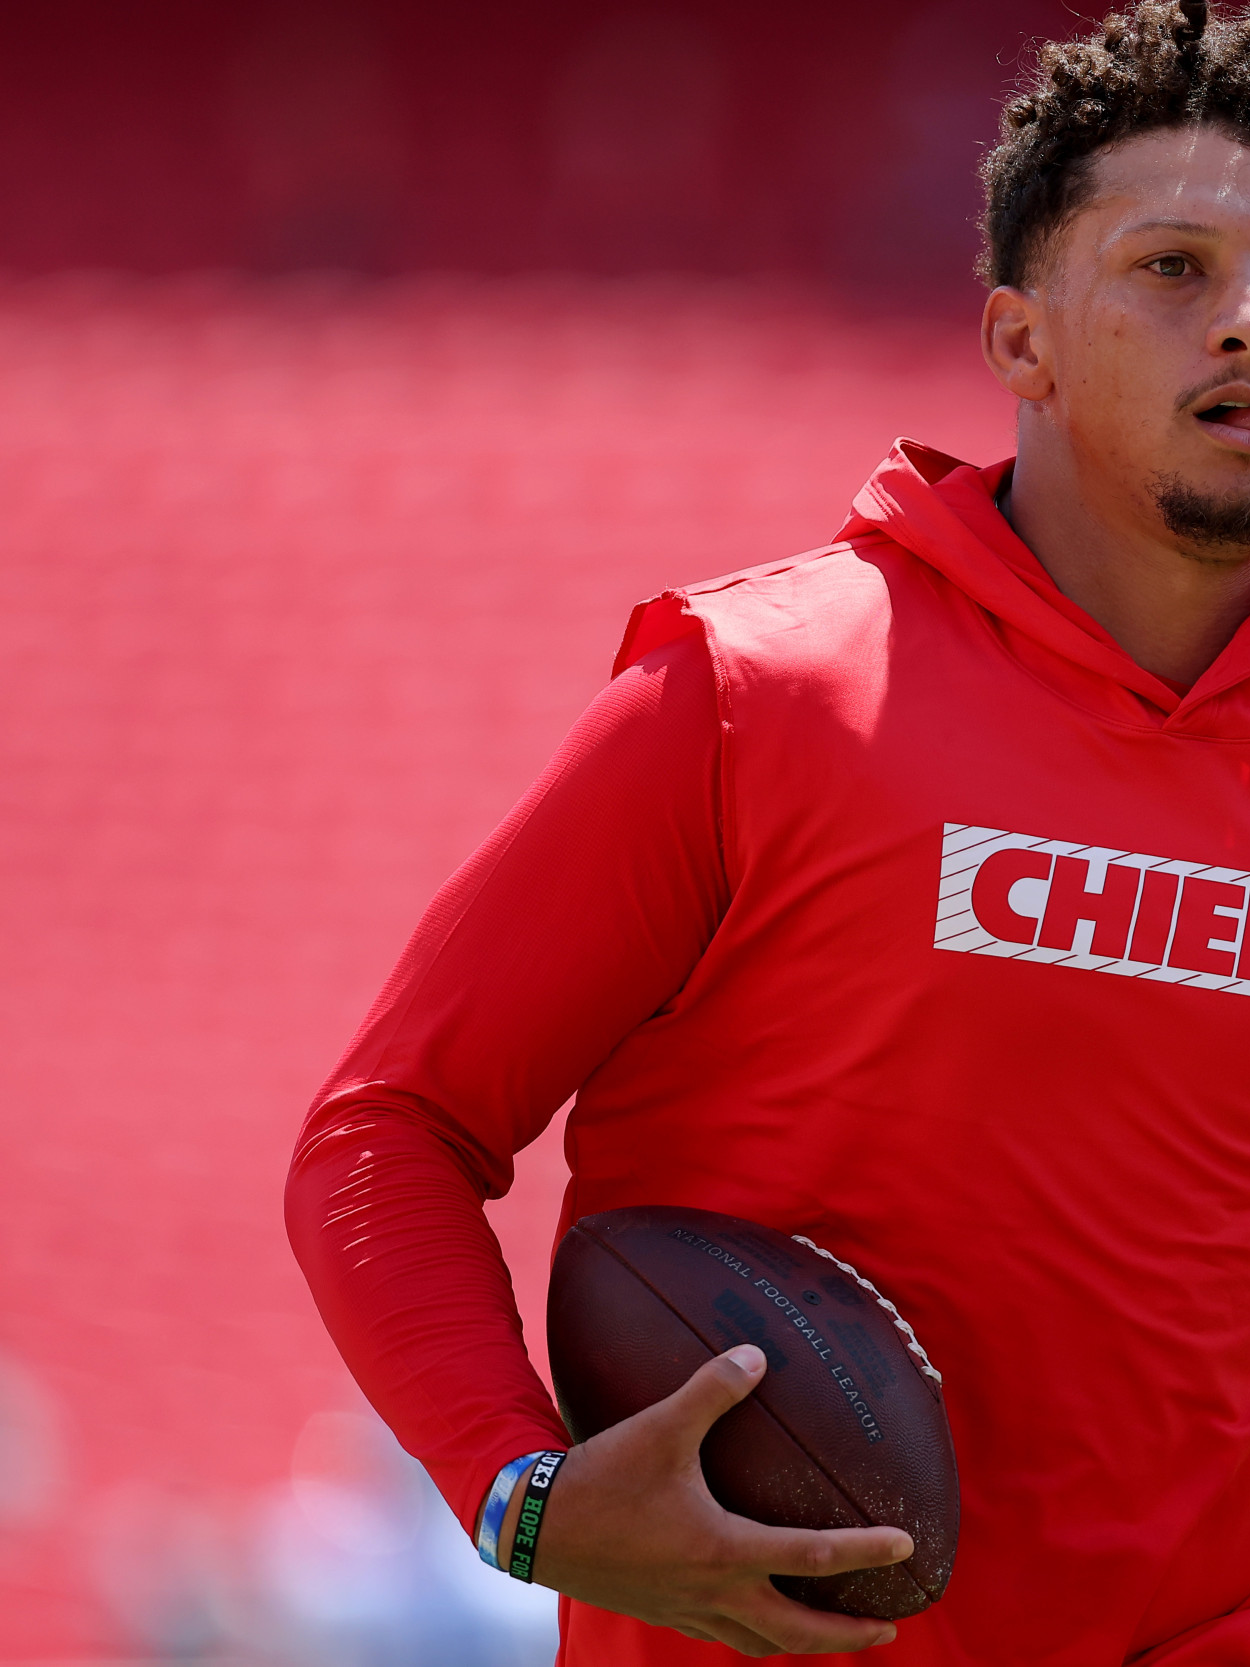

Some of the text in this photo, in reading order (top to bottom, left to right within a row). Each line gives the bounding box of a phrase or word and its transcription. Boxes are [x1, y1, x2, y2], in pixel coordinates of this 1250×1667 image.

[672, 1228, 750, 1279] NATIONAL
[753, 1277, 833, 1361] FOOTBALL
[831, 1364, 884, 1444] LEAGUE
[516, 1496, 543, 1548] HOPE
[511, 1551, 531, 1579] FOR
